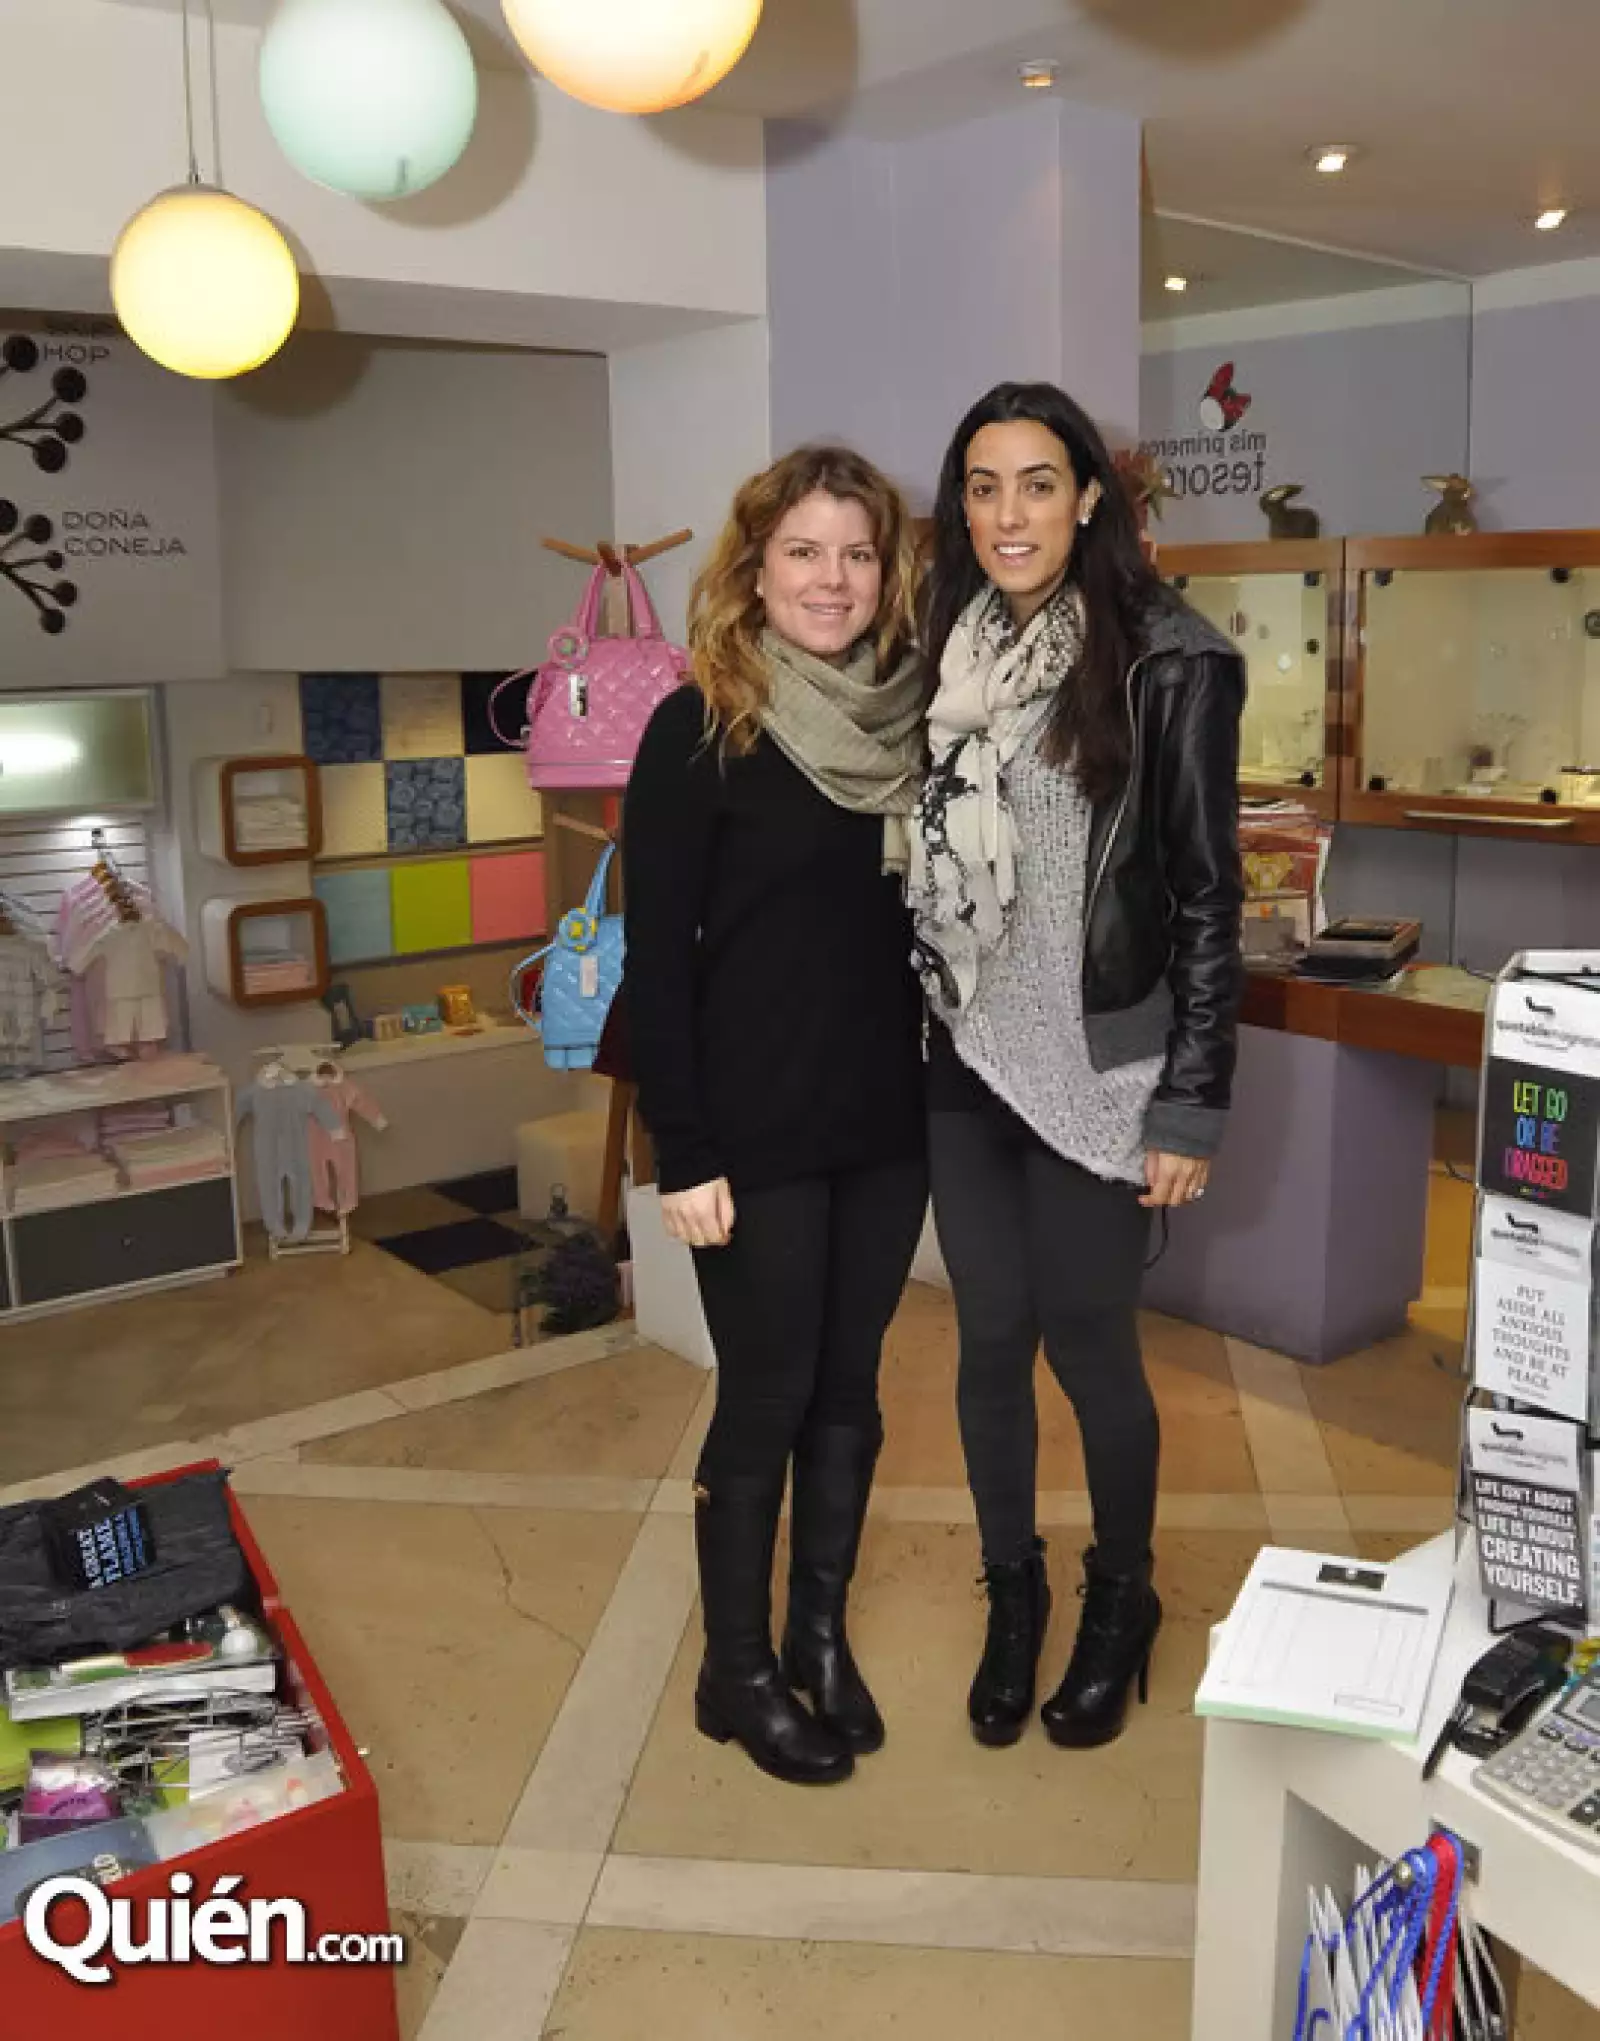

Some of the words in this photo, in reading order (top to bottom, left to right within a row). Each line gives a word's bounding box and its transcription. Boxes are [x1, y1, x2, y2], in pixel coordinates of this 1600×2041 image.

[43, 342, 110, 364] HOP
[62, 509, 150, 530] DOÑA
[64, 536, 187, 556] CONEJA
[1513, 1080, 1541, 1115] LET
[1546, 1088, 1568, 1121] GO
[1516, 1115, 1536, 1148] OR
[1541, 1121, 1561, 1153] BE
[1517, 1284, 1545, 1302] PUT
[1497, 1298, 1536, 1317] ASIDE
[1542, 1310, 1565, 1326] ALL
[1493, 1328, 1570, 1361] THOUGHTS
[1494, 1346, 1523, 1364] AND
[1482, 1534, 1580, 1579] CREATING
